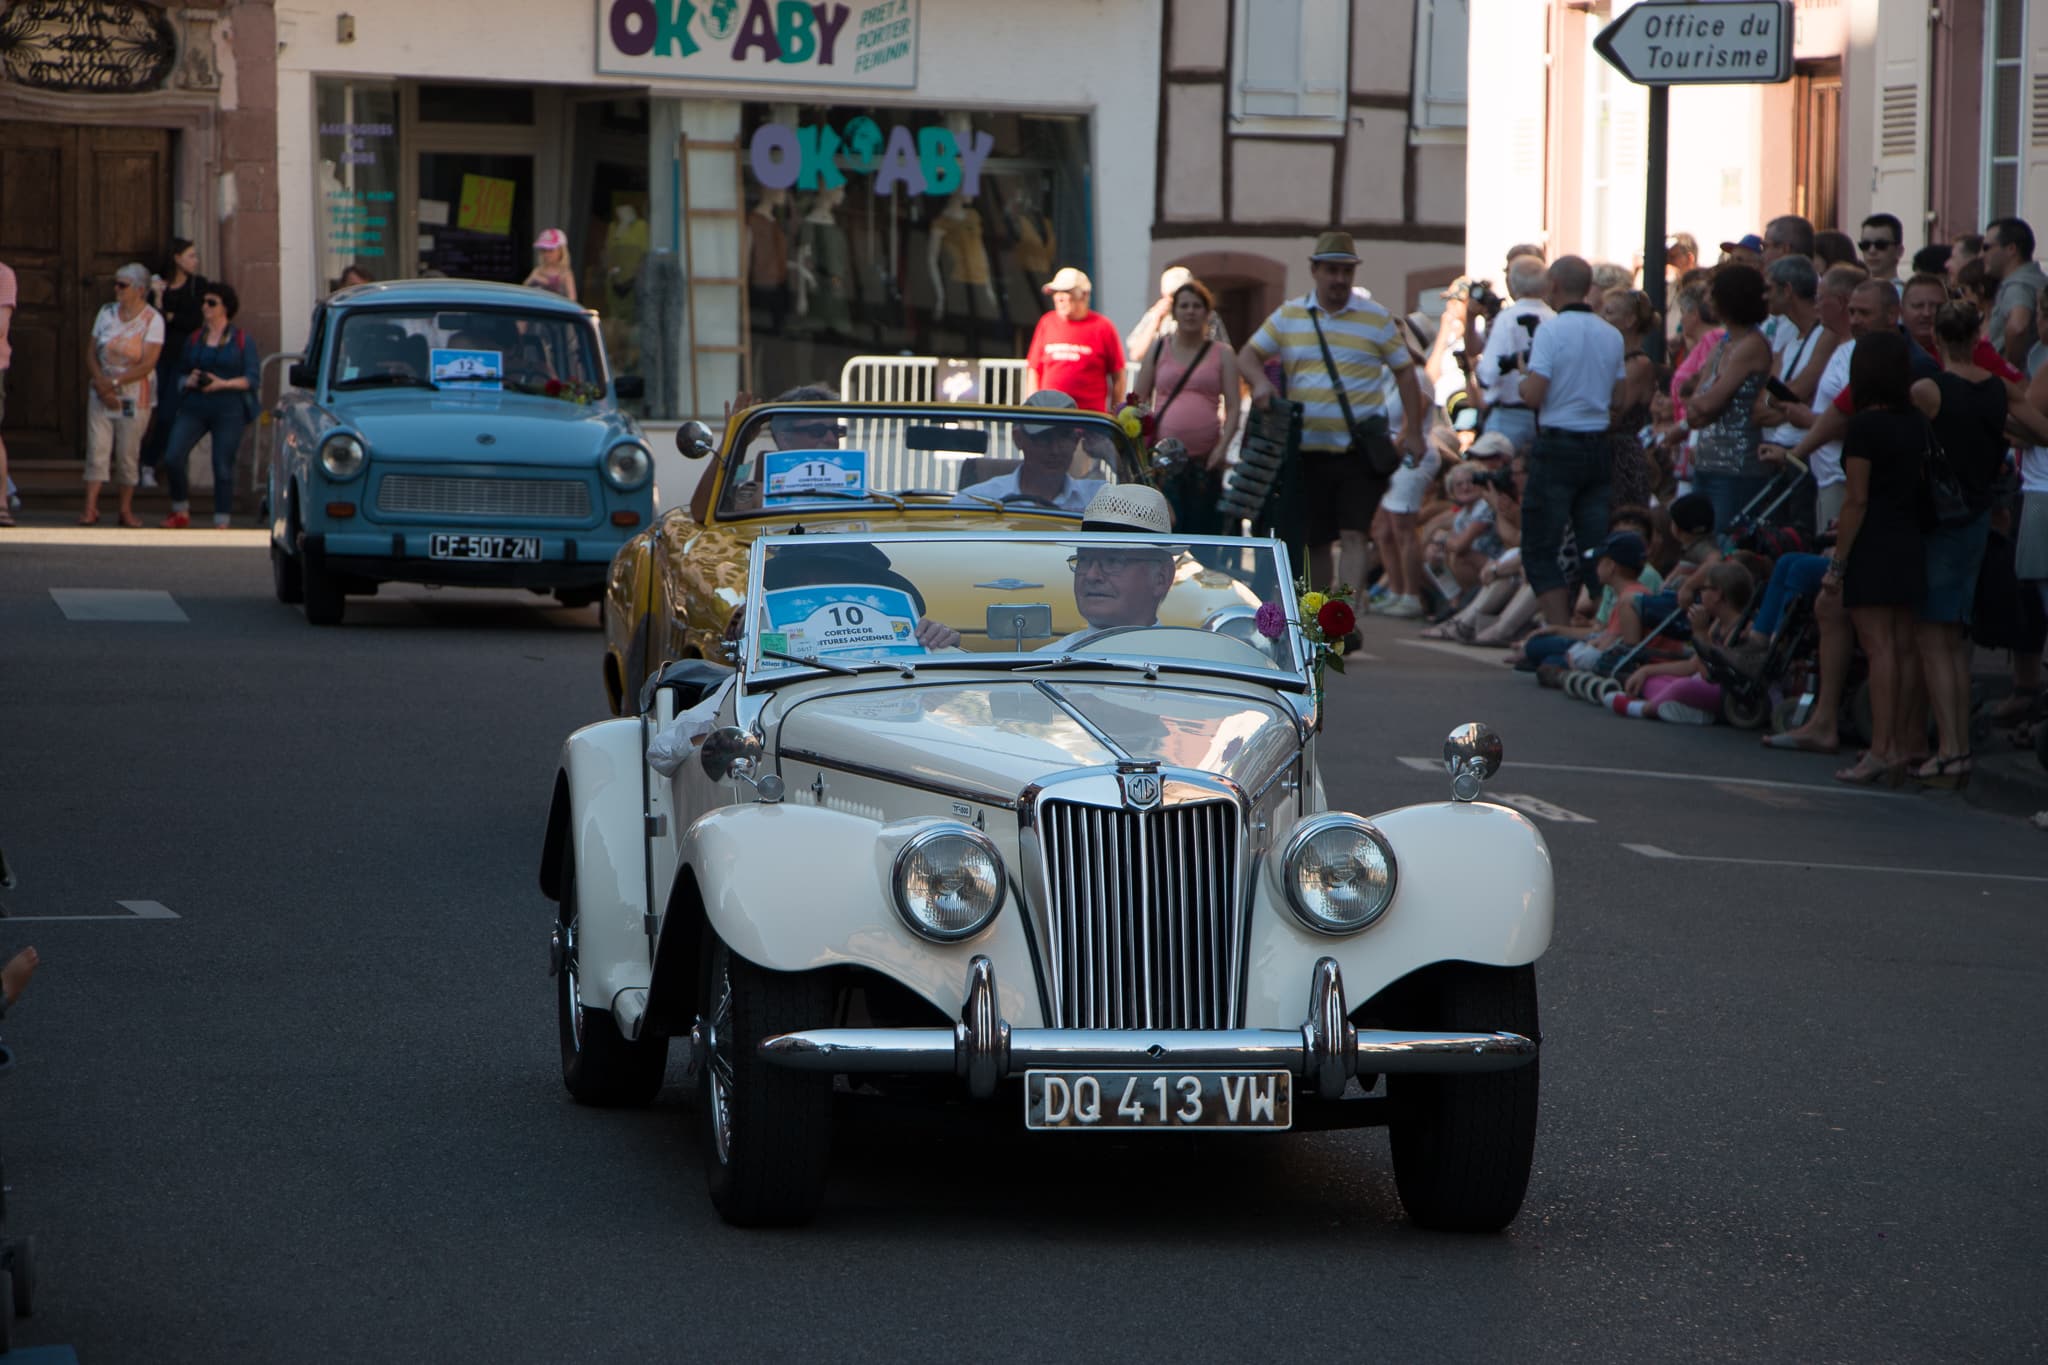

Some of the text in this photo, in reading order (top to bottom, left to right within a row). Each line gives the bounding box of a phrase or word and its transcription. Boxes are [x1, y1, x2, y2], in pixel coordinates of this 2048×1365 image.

[855, 18, 911, 51] PORTER
[1645, 13, 1770, 39] Office du
[1648, 45, 1769, 69] Tourisme
[459, 360, 474, 371] 12
[805, 464, 825, 476] 11
[435, 535, 537, 559] CF-507-ZN
[828, 606, 864, 627] 10
[824, 627, 873, 637] CORTÈGE DE
[850, 634, 894, 644] ANCIENNES
[1133, 778, 1155, 800] MG
[1044, 1076, 1276, 1123] DQ 413 VW
